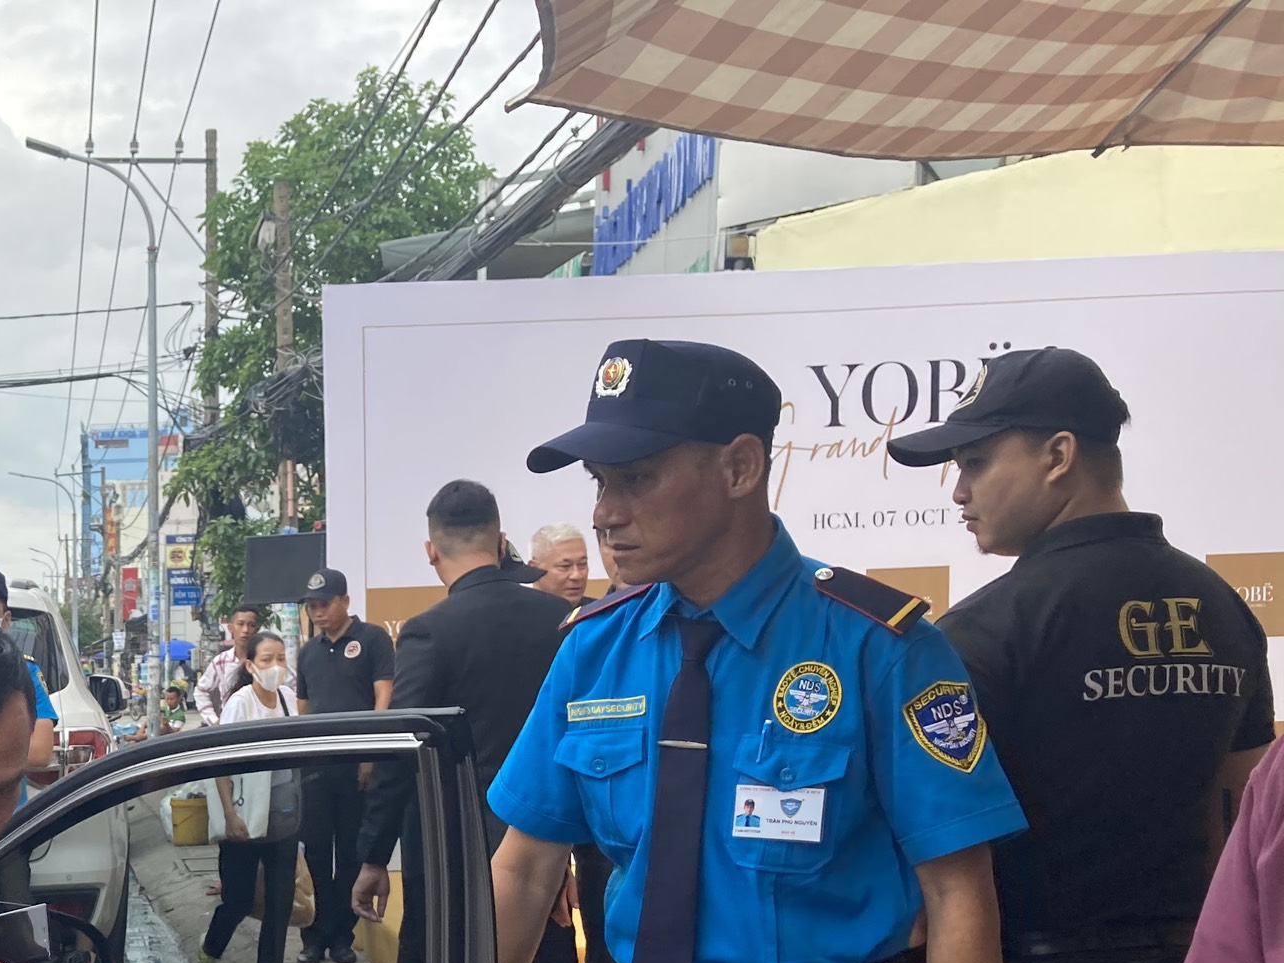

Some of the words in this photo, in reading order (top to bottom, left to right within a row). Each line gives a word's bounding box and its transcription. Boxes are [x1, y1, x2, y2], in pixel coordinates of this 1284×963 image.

[805, 341, 1012, 428] YOB
[813, 512, 866, 530] HCM,
[872, 510, 897, 528] 07
[905, 508, 951, 526] OCT
[1233, 582, 1274, 602] OBË
[1118, 597, 1214, 660] GE
[799, 679, 822, 692] NDS
[1083, 663, 1246, 701] SECURITY
[913, 685, 968, 711] SECURITY
